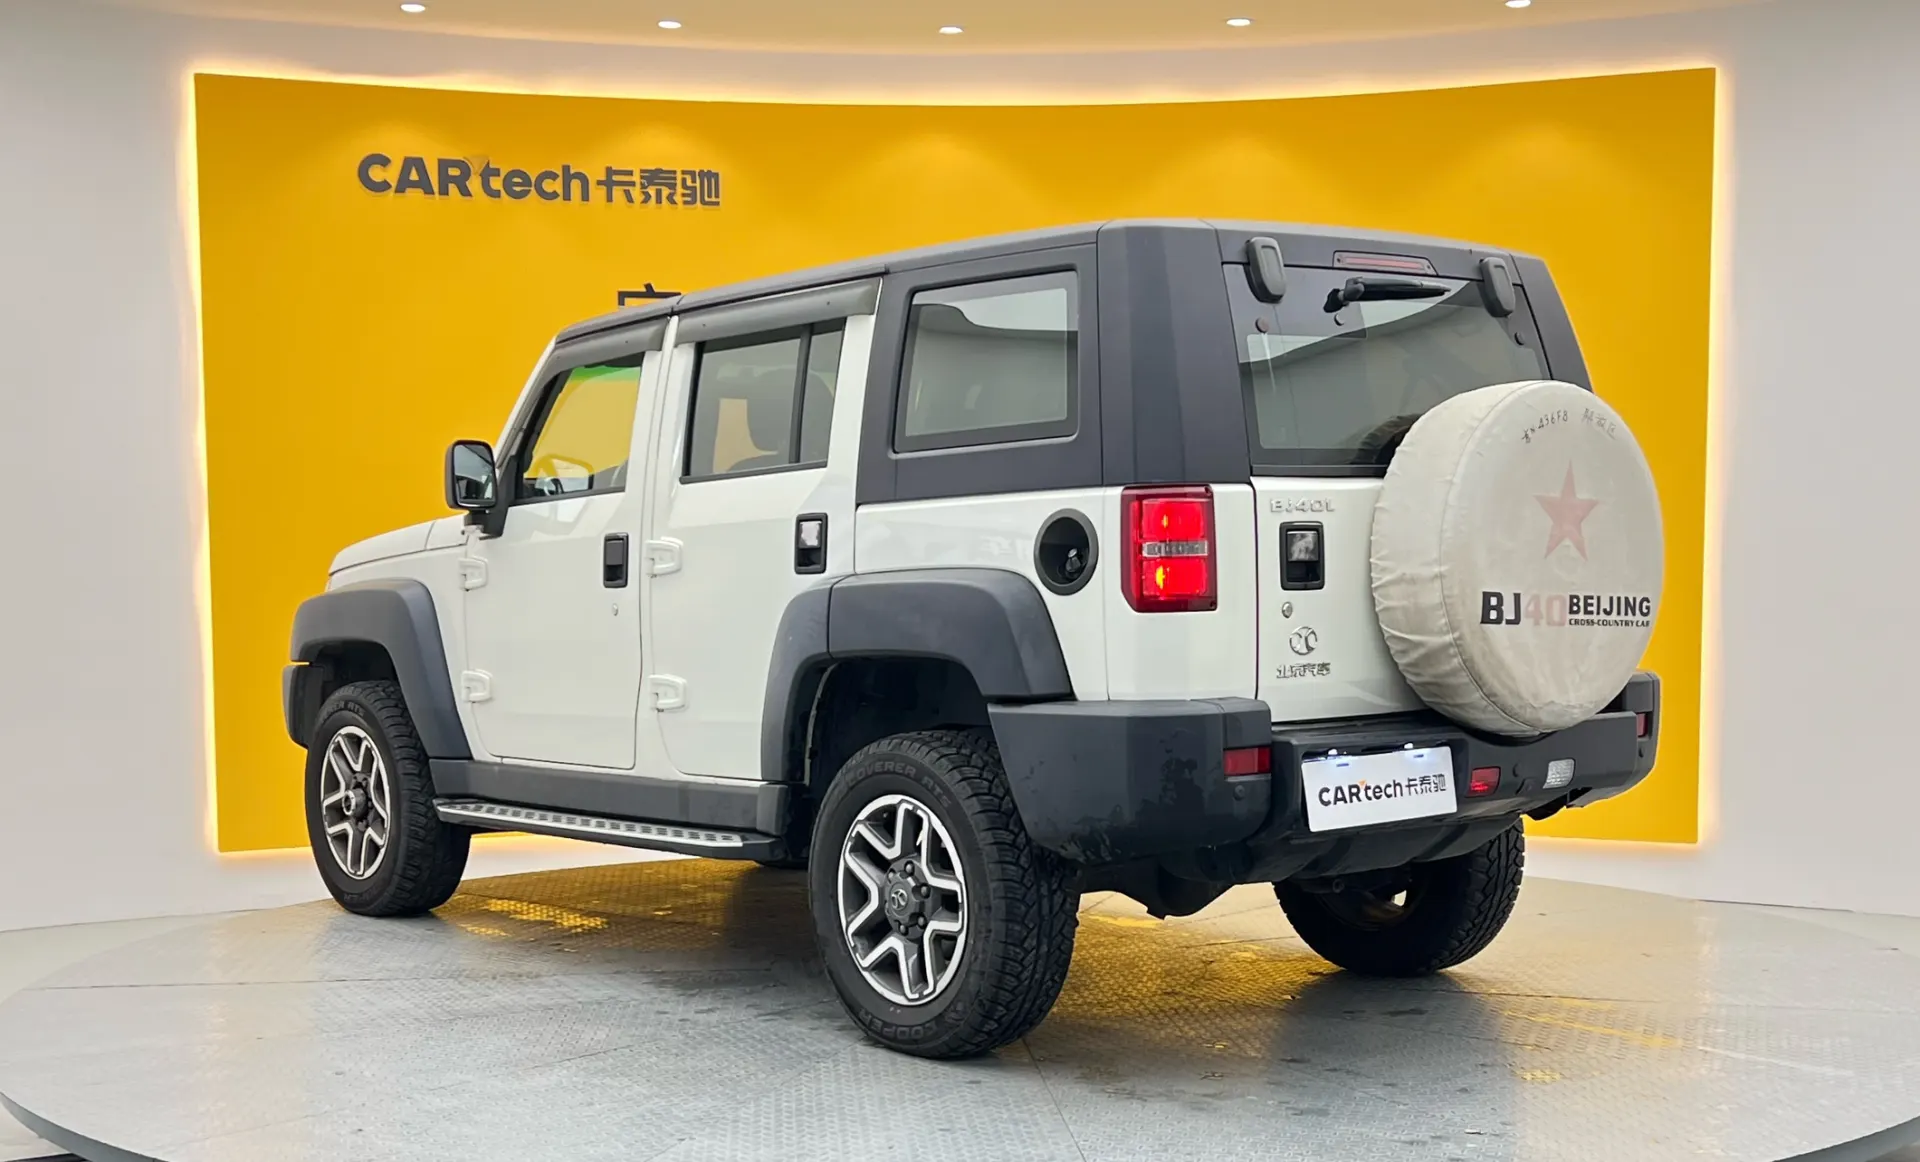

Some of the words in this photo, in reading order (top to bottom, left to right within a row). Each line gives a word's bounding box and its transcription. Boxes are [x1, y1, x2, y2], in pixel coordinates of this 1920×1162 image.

[357, 153, 590, 202] CARtech
[596, 165, 721, 207] 卡泰驰
[1568, 594, 1651, 617] BEIJING
[1318, 779, 1403, 807] CARtech
[1405, 773, 1446, 797] 卡泰驰
